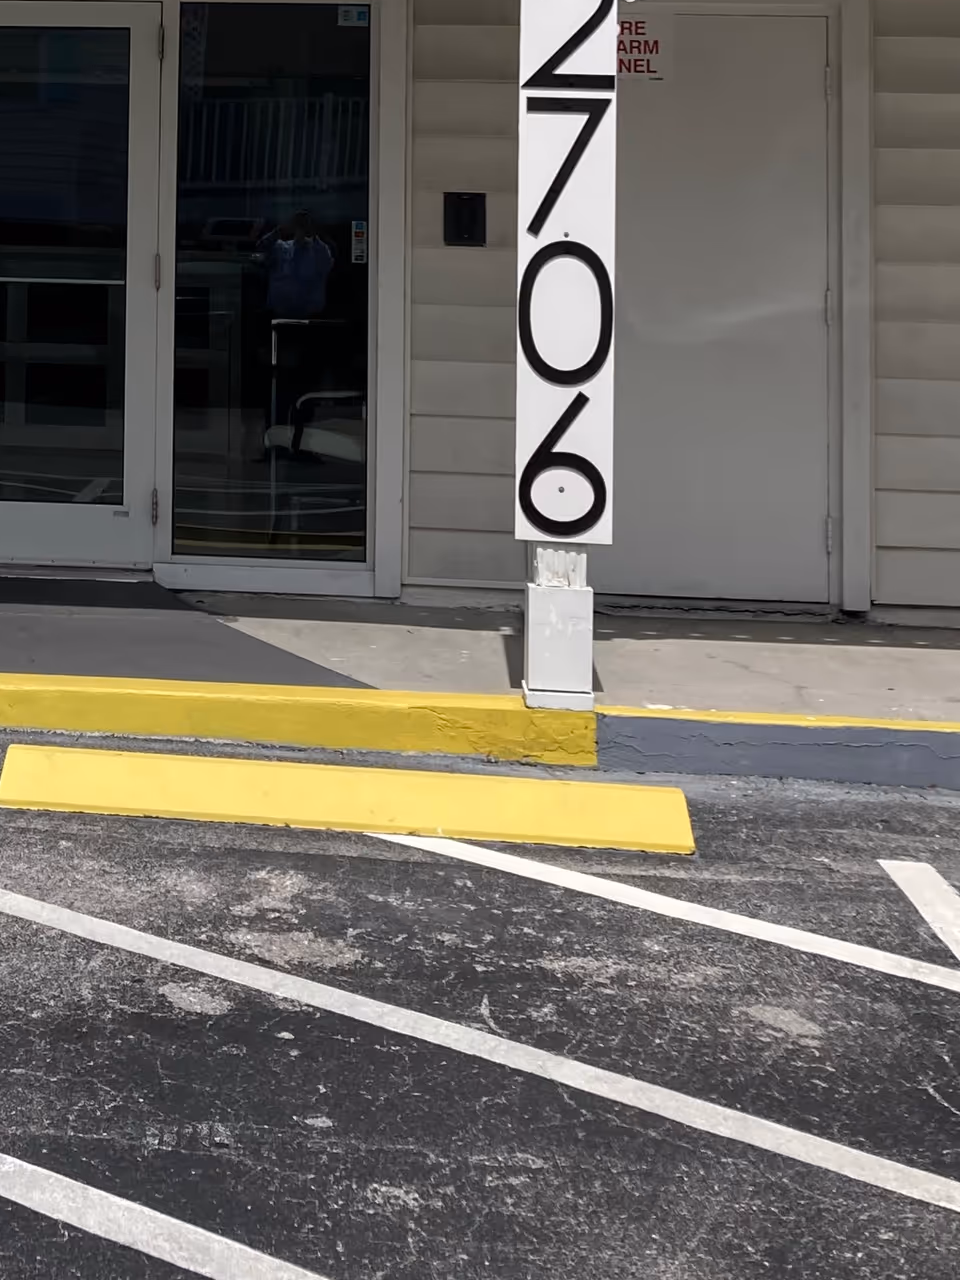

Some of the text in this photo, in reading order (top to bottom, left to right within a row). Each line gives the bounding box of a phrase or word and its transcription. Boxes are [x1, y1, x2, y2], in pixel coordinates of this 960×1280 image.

[620, 20, 647, 36] RE
[617, 39, 660, 55] ARM
[618, 58, 658, 74] NEL
